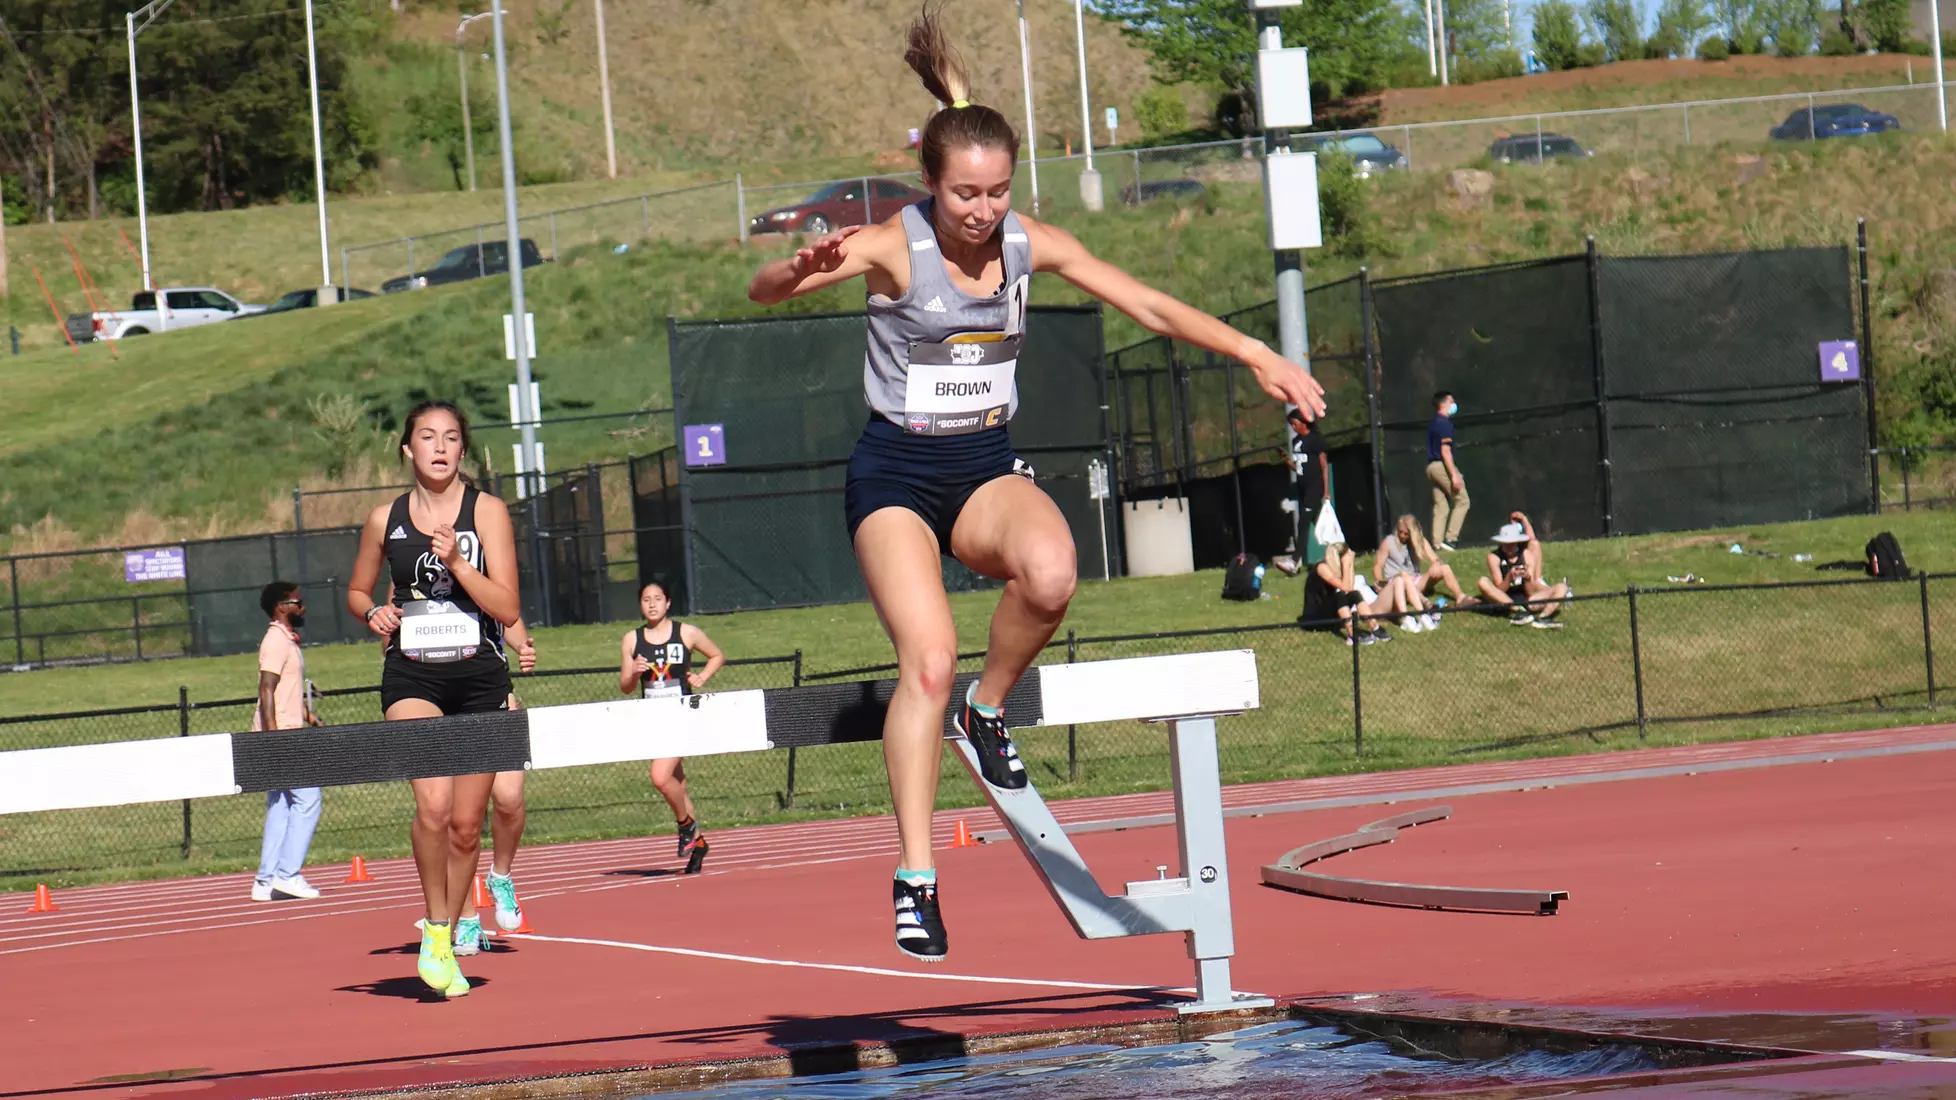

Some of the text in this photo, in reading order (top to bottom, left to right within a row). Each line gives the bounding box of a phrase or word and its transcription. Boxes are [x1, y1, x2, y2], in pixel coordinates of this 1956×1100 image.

[1831, 351, 1849, 373] 4
[935, 380, 992, 397] BROWN
[936, 416, 980, 429] #SOCONTF
[985, 407, 1002, 428] C
[697, 435, 714, 457] 1
[415, 624, 467, 636] ROBERTS
[670, 645, 681, 662] 4
[1201, 868, 1215, 879] 30
